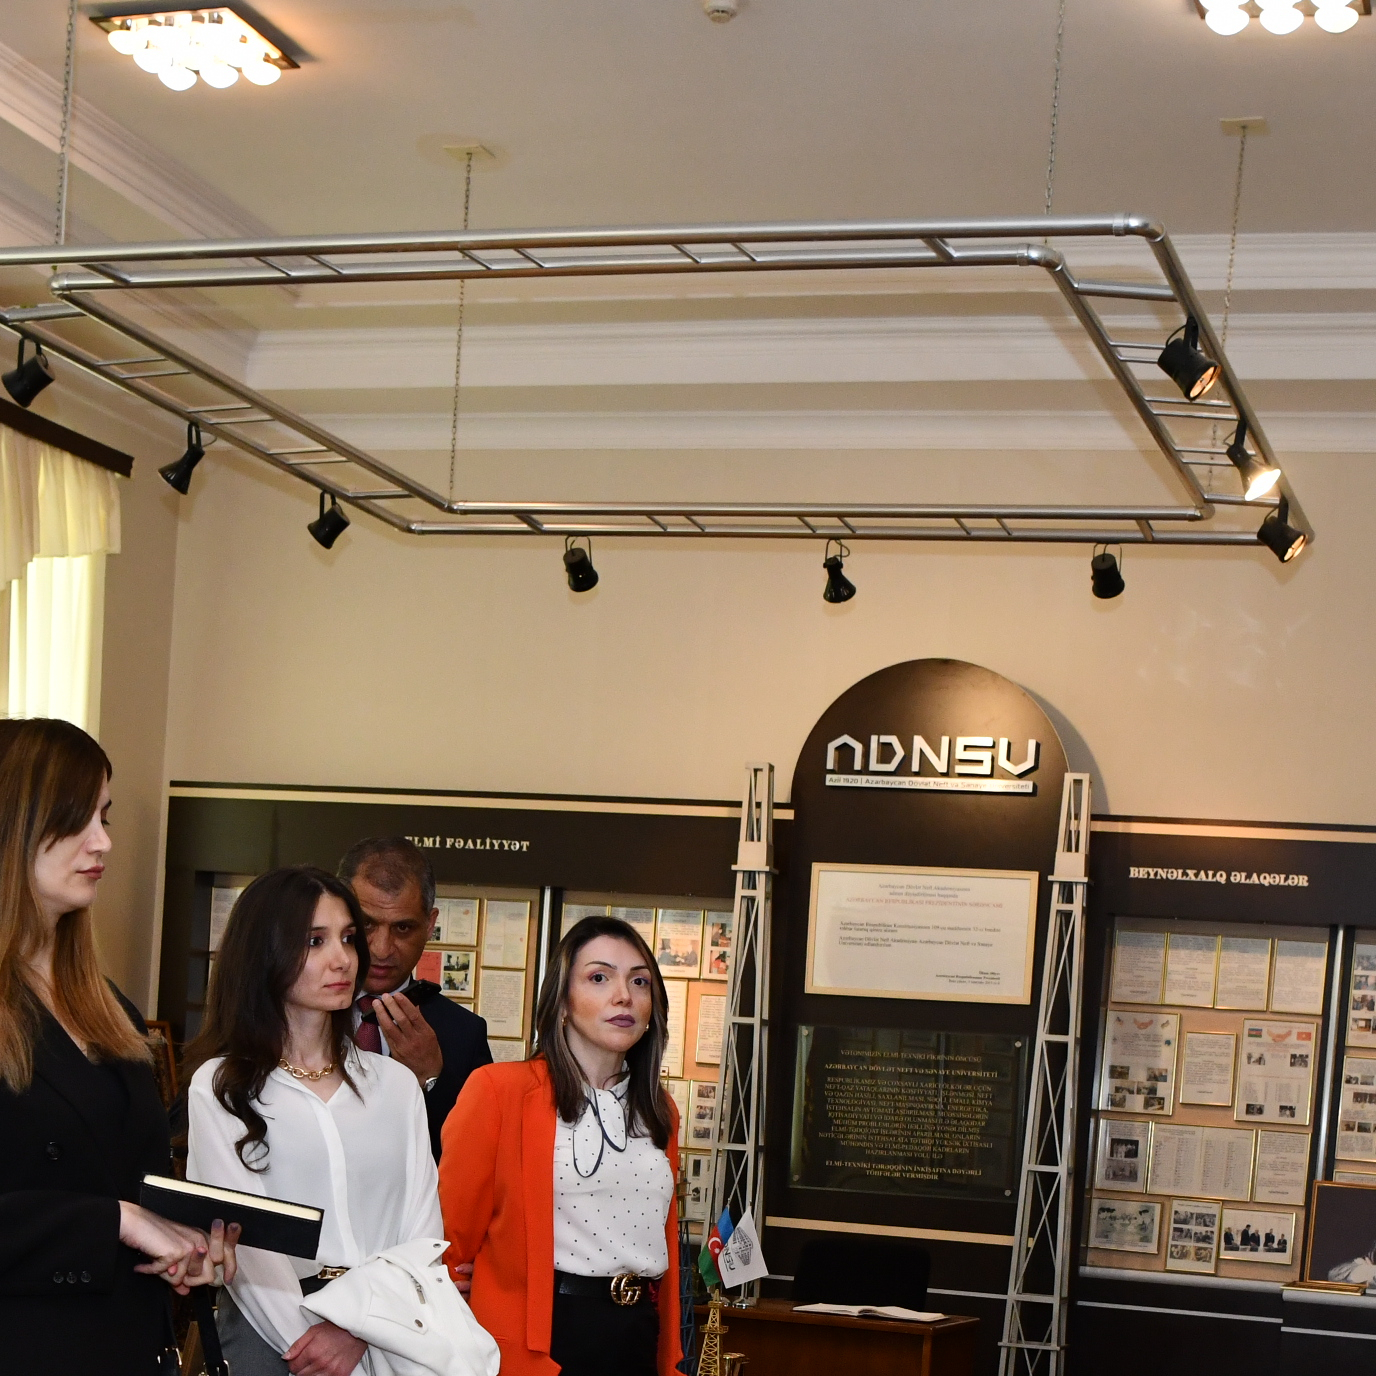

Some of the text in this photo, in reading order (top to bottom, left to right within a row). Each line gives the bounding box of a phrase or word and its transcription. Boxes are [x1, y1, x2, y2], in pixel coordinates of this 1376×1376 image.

[445, 837, 530, 852] FƏALİYYƏT
[1129, 866, 1309, 887] BEYNƏLXALQ ƏLAQƏLƏR
